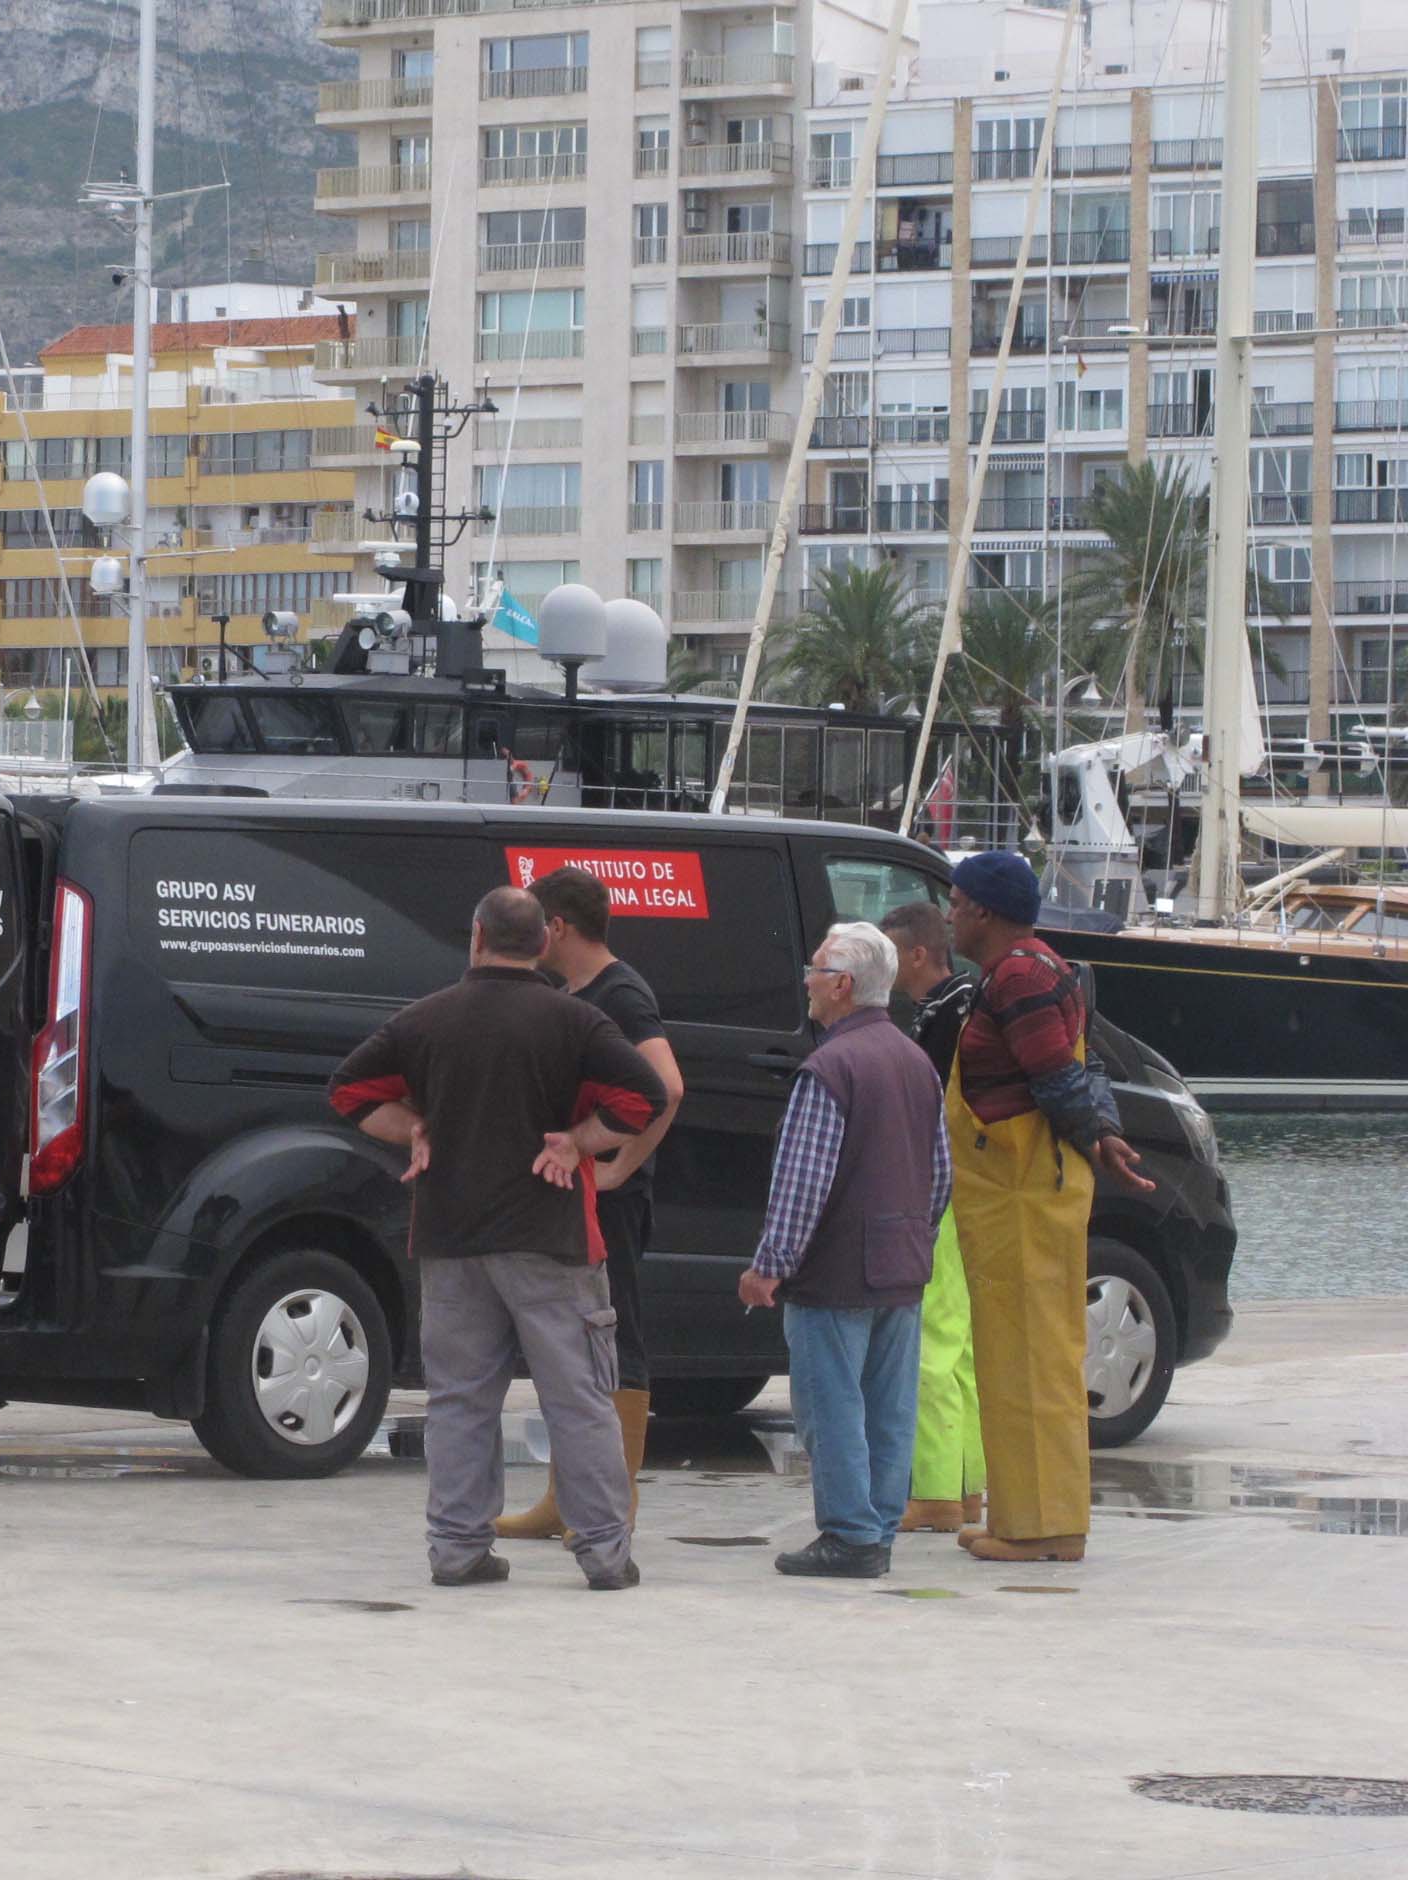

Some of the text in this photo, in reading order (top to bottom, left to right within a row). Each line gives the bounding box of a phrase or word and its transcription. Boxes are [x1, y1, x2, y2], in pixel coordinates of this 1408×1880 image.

[651, 862, 675, 880] DE
[156, 880, 256, 901] GRUPO ASV
[644, 888, 696, 907] LEGAL
[158, 909, 366, 935] SERVICIOS FUNERARIOS
[160, 938, 365, 957] www.grupoasvserviciosfunerarios.com
